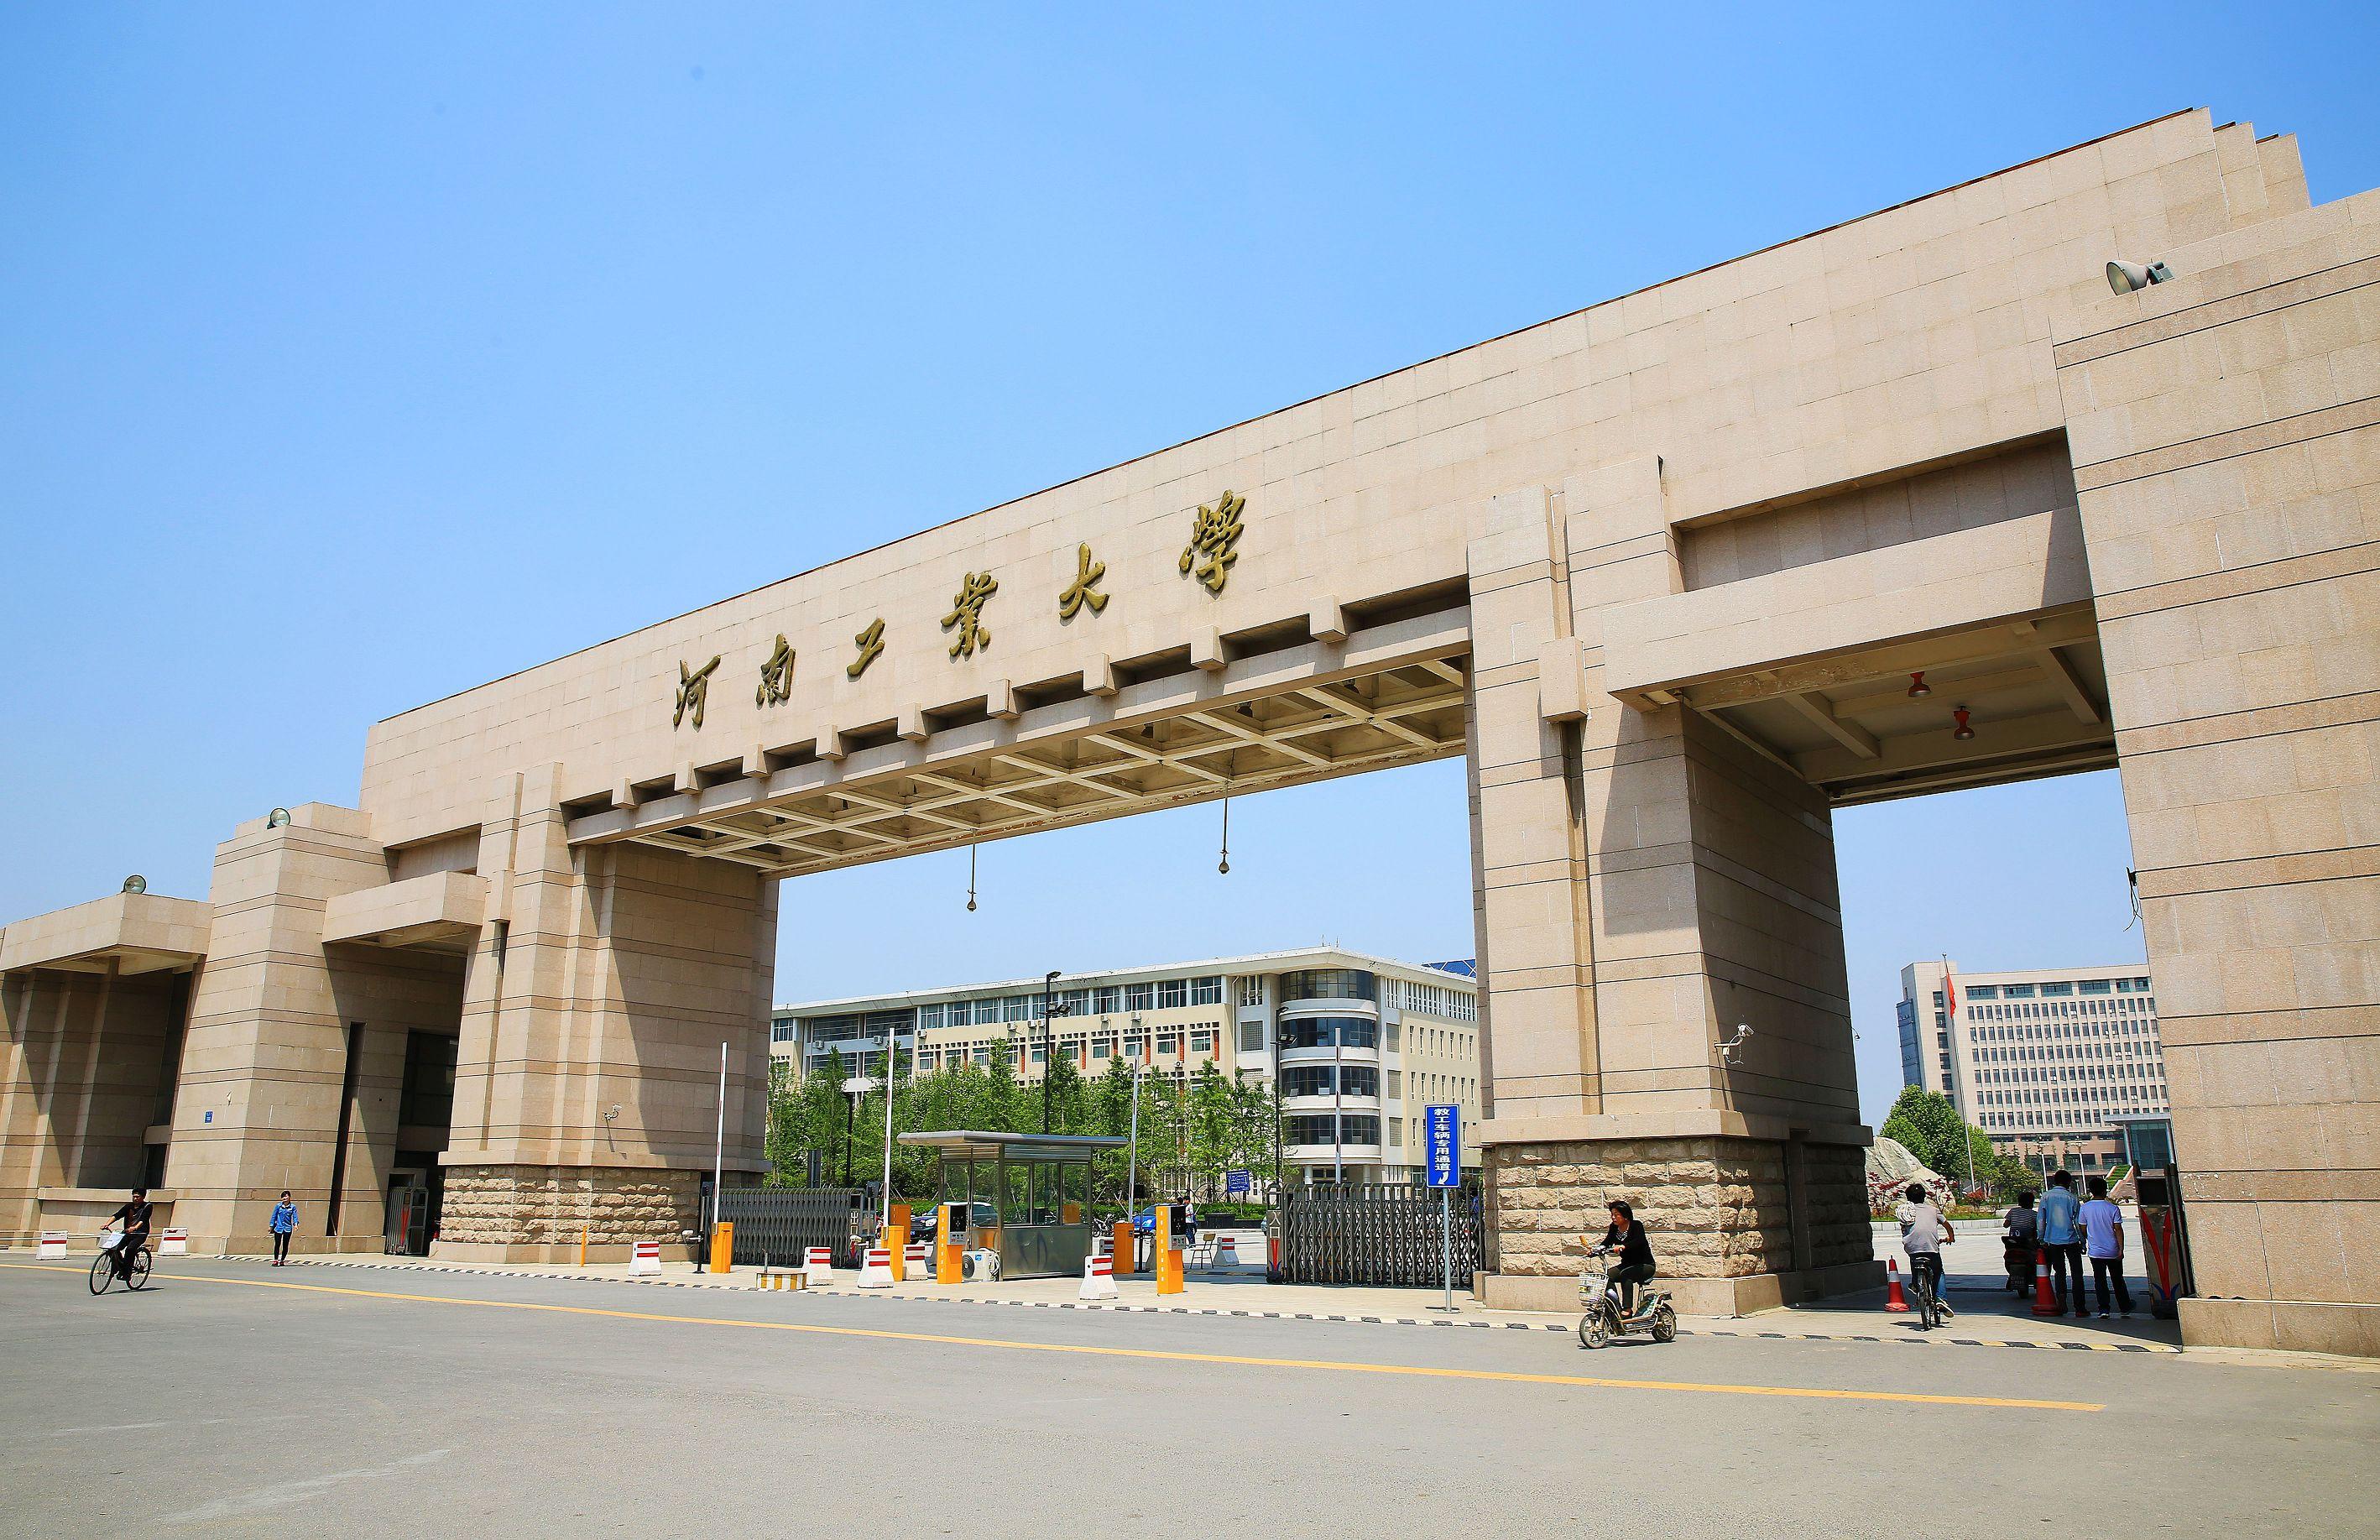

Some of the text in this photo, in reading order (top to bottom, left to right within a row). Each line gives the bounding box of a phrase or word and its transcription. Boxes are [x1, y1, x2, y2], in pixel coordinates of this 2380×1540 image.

[1433, 1108, 1452, 1171] 教工车辆专用通道
[1269, 1211, 1281, 1239] 入口
